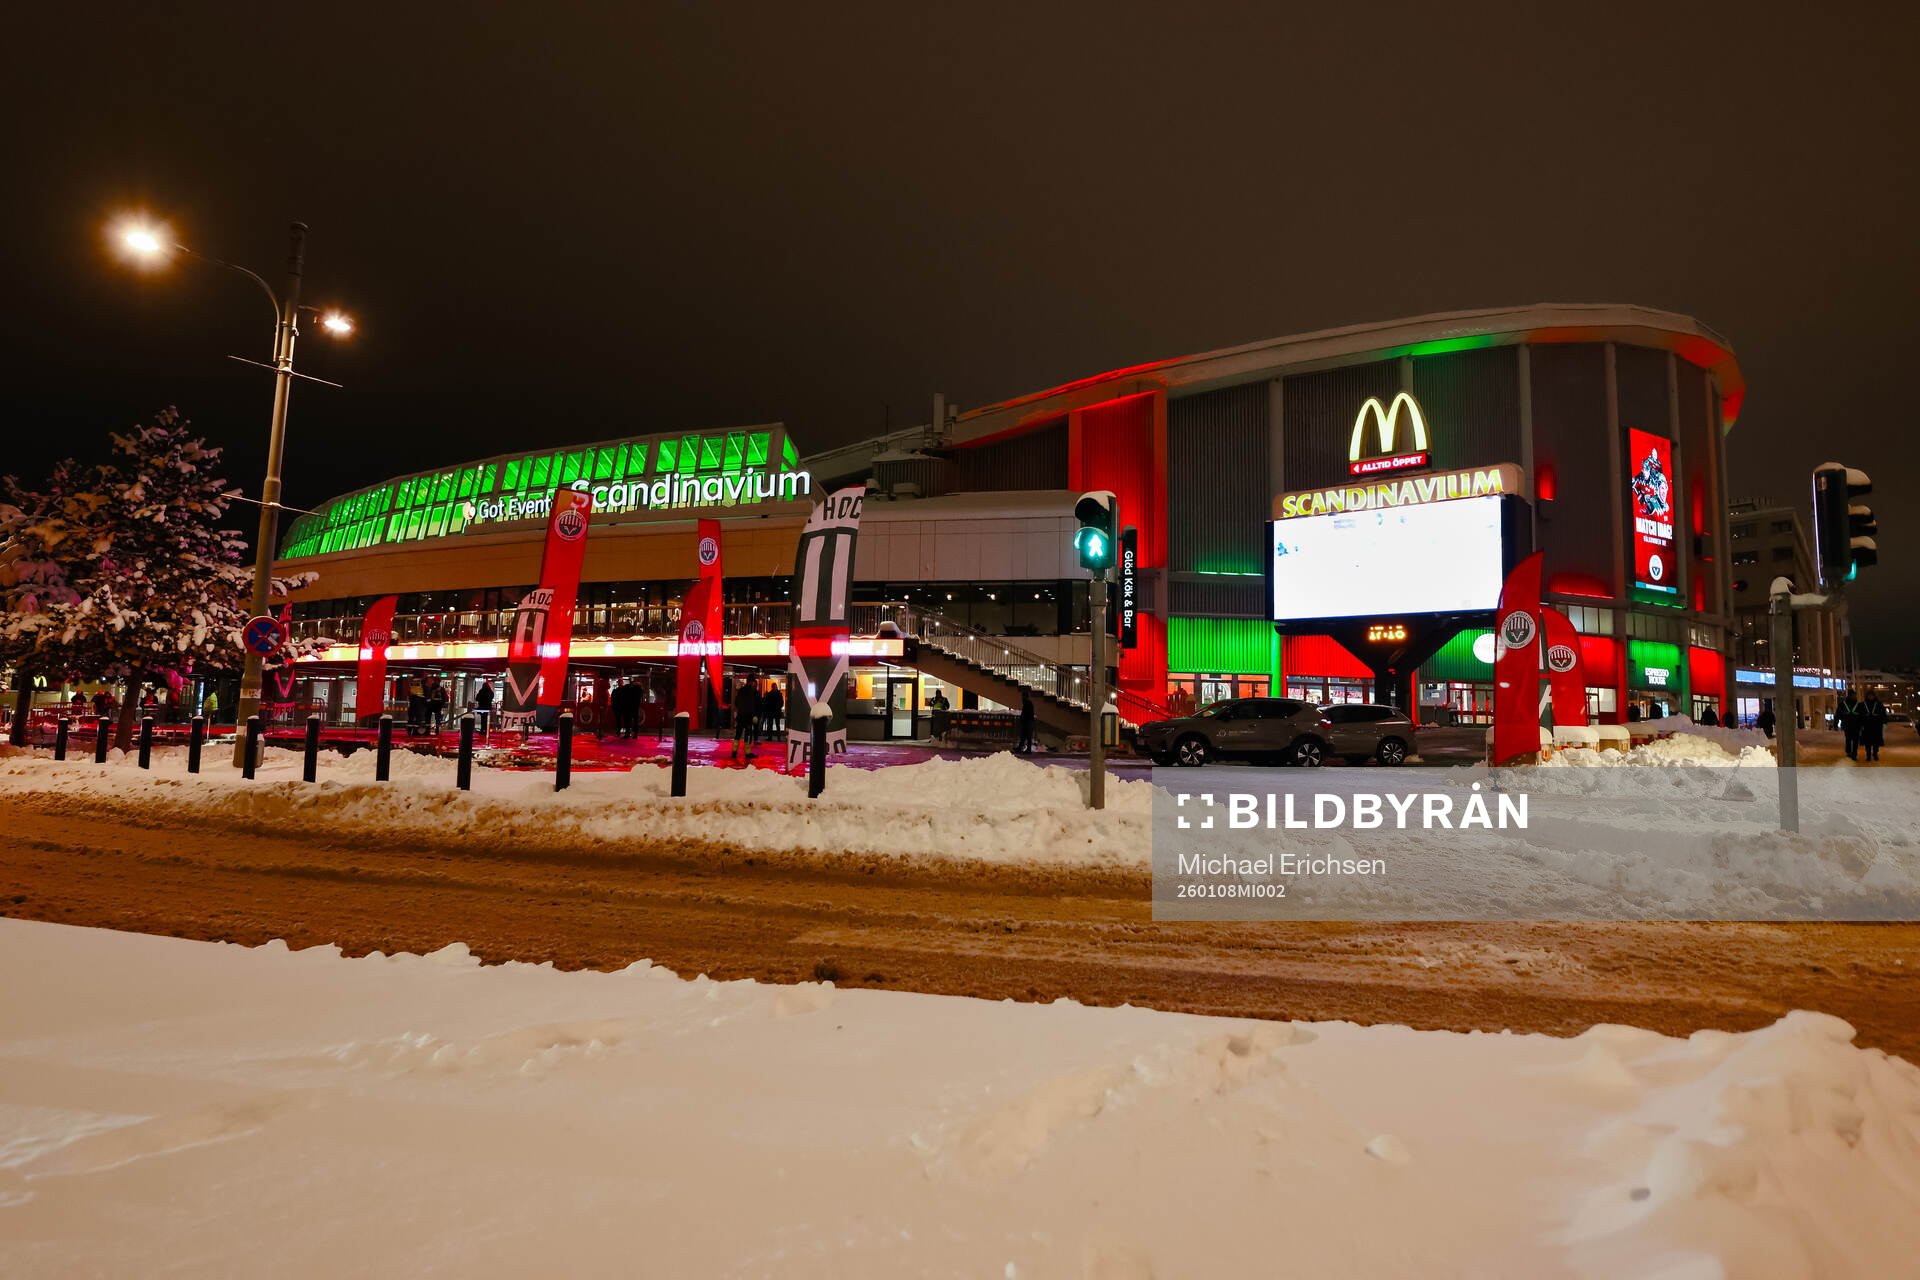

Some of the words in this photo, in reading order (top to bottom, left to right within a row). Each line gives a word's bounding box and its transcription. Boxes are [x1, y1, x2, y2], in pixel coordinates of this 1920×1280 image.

[1362, 461, 1391, 471] ALLTID
[1392, 456, 1422, 467] ÖPPET
[1283, 469, 1503, 518] SCANDINAVIUM
[479, 502, 505, 518] Got
[1124, 550, 1133, 575] Glöd
[1124, 578, 1133, 598] Kök
[1124, 610, 1133, 628] Bar
